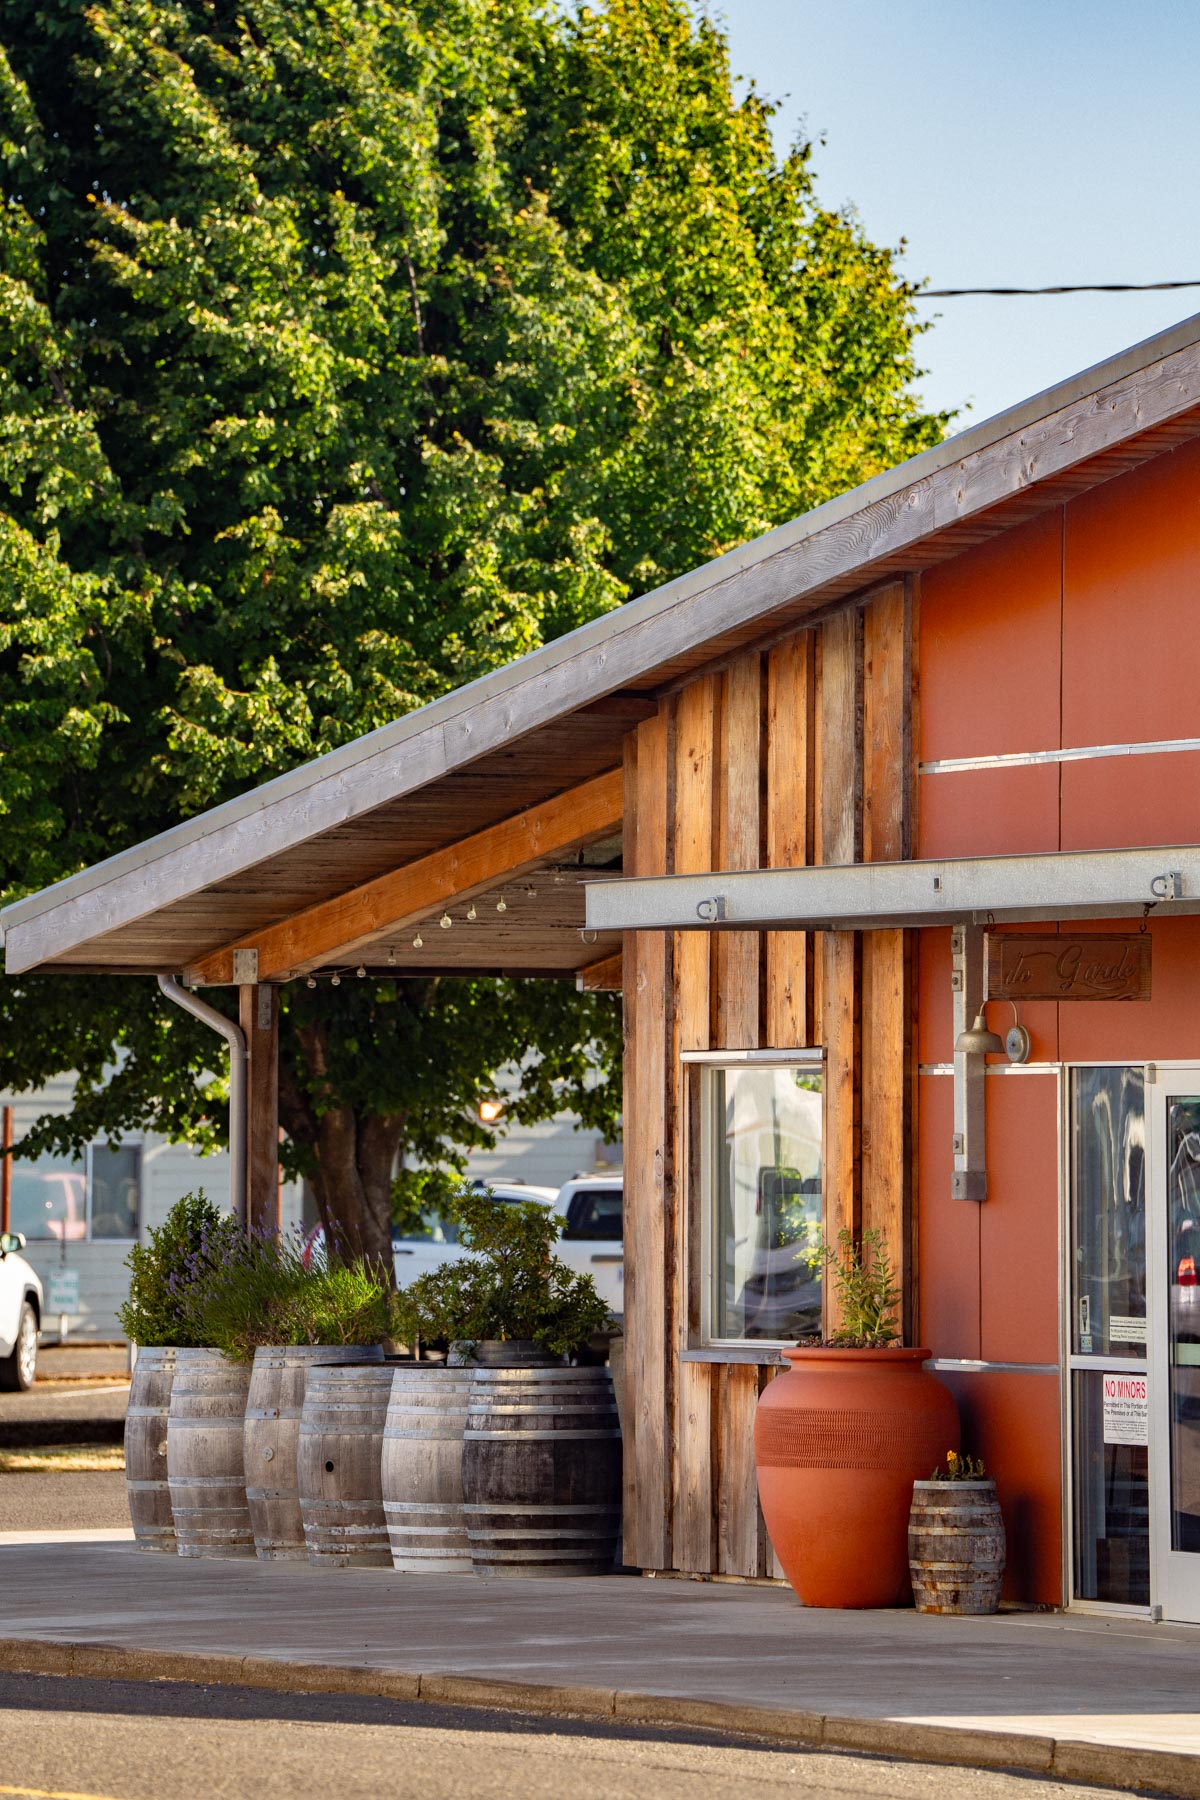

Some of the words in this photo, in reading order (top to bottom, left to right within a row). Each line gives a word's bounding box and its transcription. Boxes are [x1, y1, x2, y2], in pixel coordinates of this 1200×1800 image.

[1056, 945, 1135, 991] Garde
[1105, 1380, 1116, 1398] NO
[1118, 1380, 1146, 1400] MINORS
